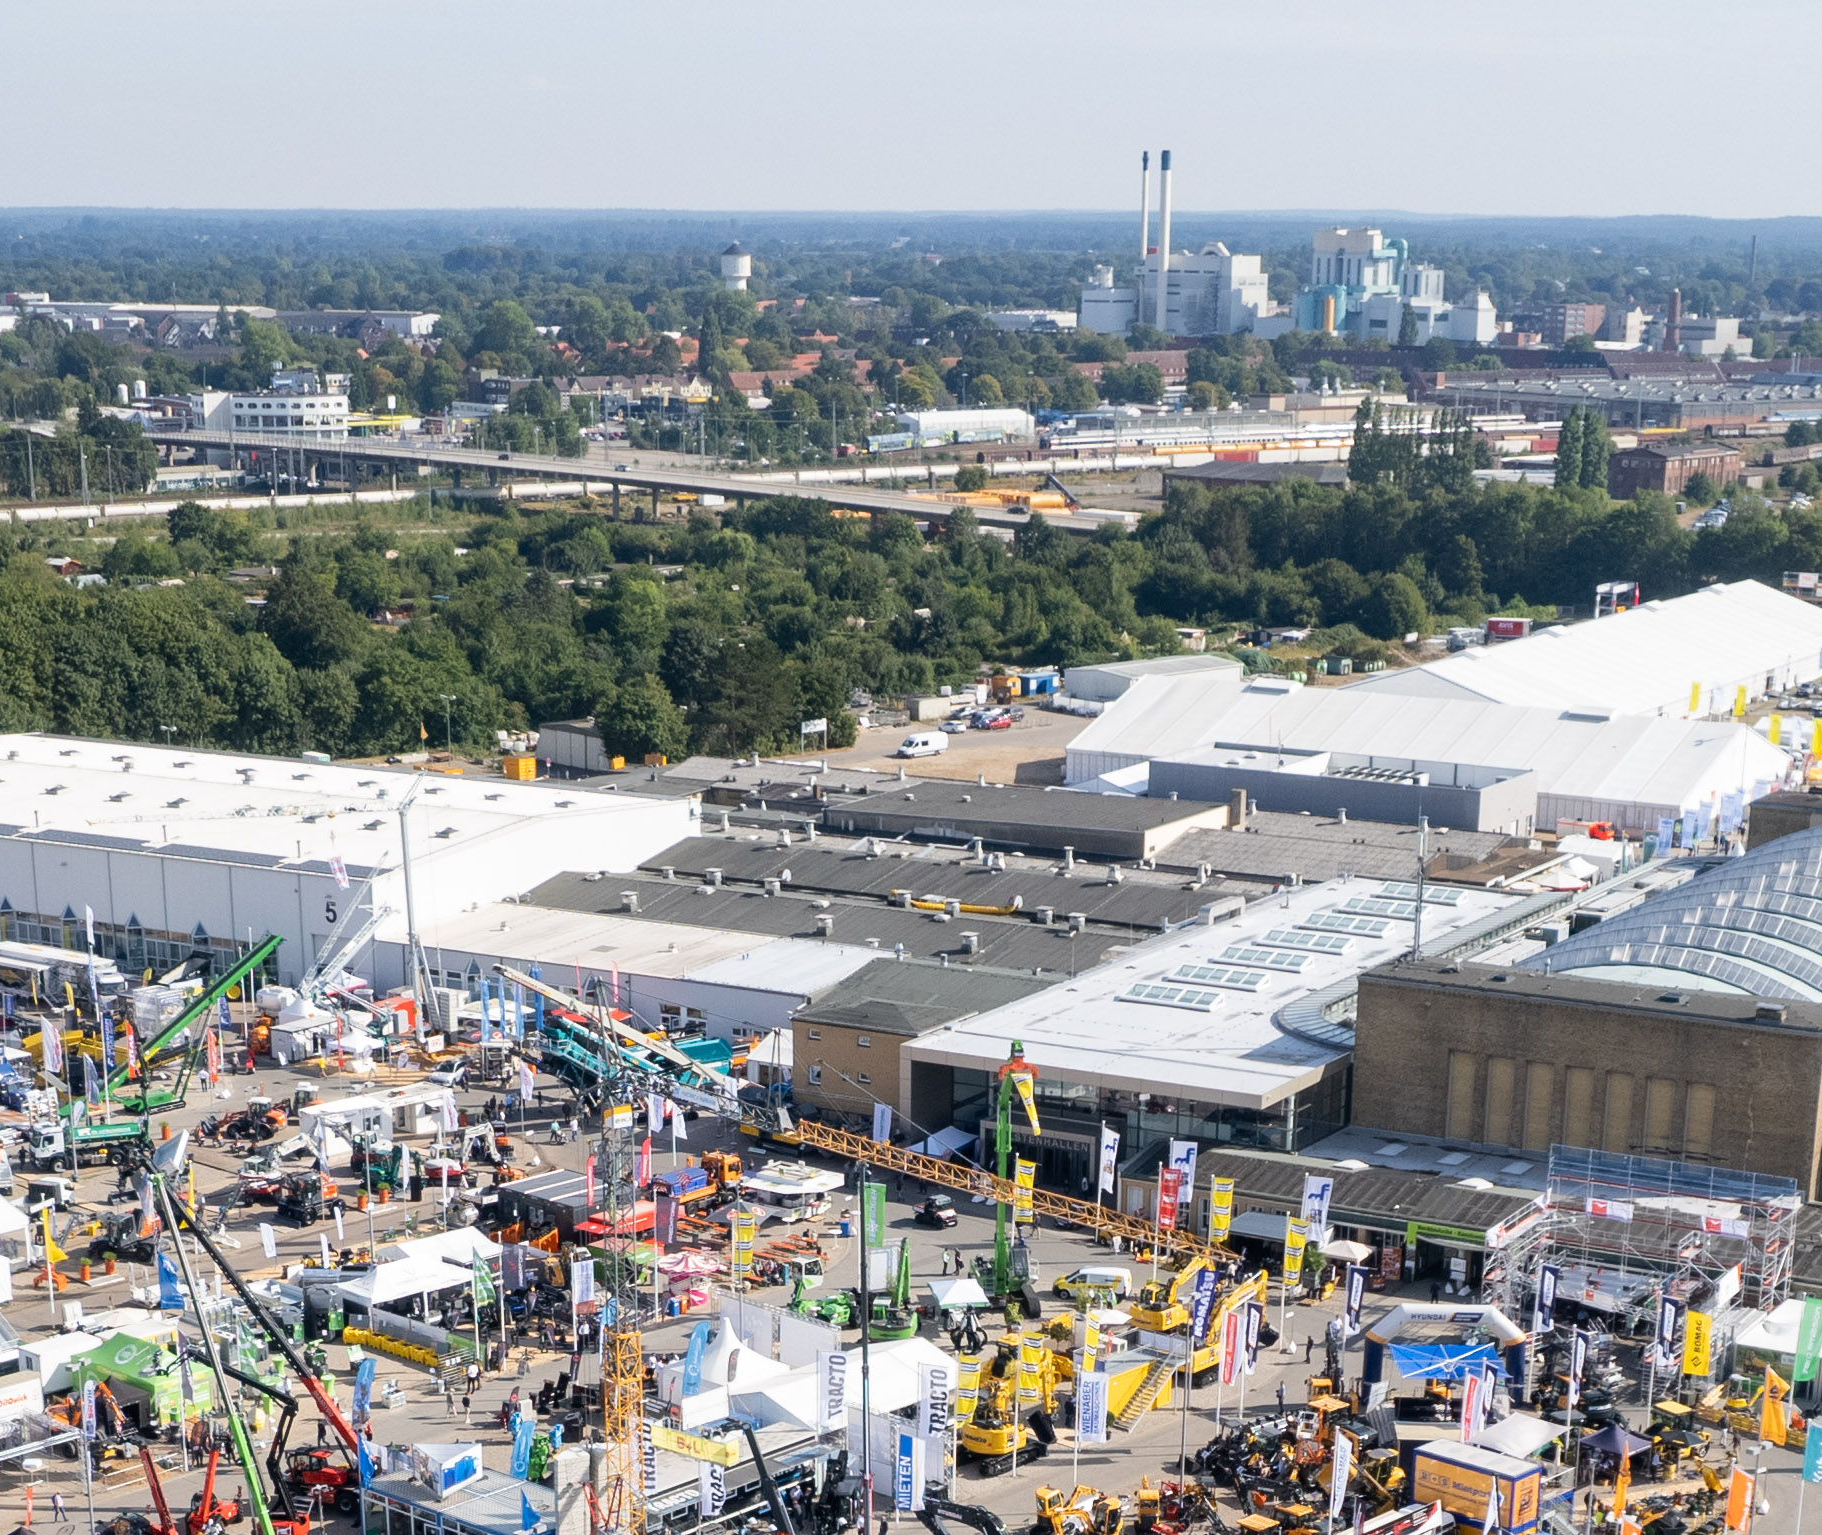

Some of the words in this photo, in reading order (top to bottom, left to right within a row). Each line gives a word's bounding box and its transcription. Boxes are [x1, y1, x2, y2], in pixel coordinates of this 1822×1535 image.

[325, 901, 337, 923] 5
[1193, 1271, 1217, 1338] KOMATSU
[1693, 1319, 1704, 1353] BOMAG
[827, 1354, 847, 1420] TRACTO
[928, 1368, 948, 1435] TRACTO
[675, 1434, 701, 1455] B+L
[897, 1455, 912, 1508] MIETEN
